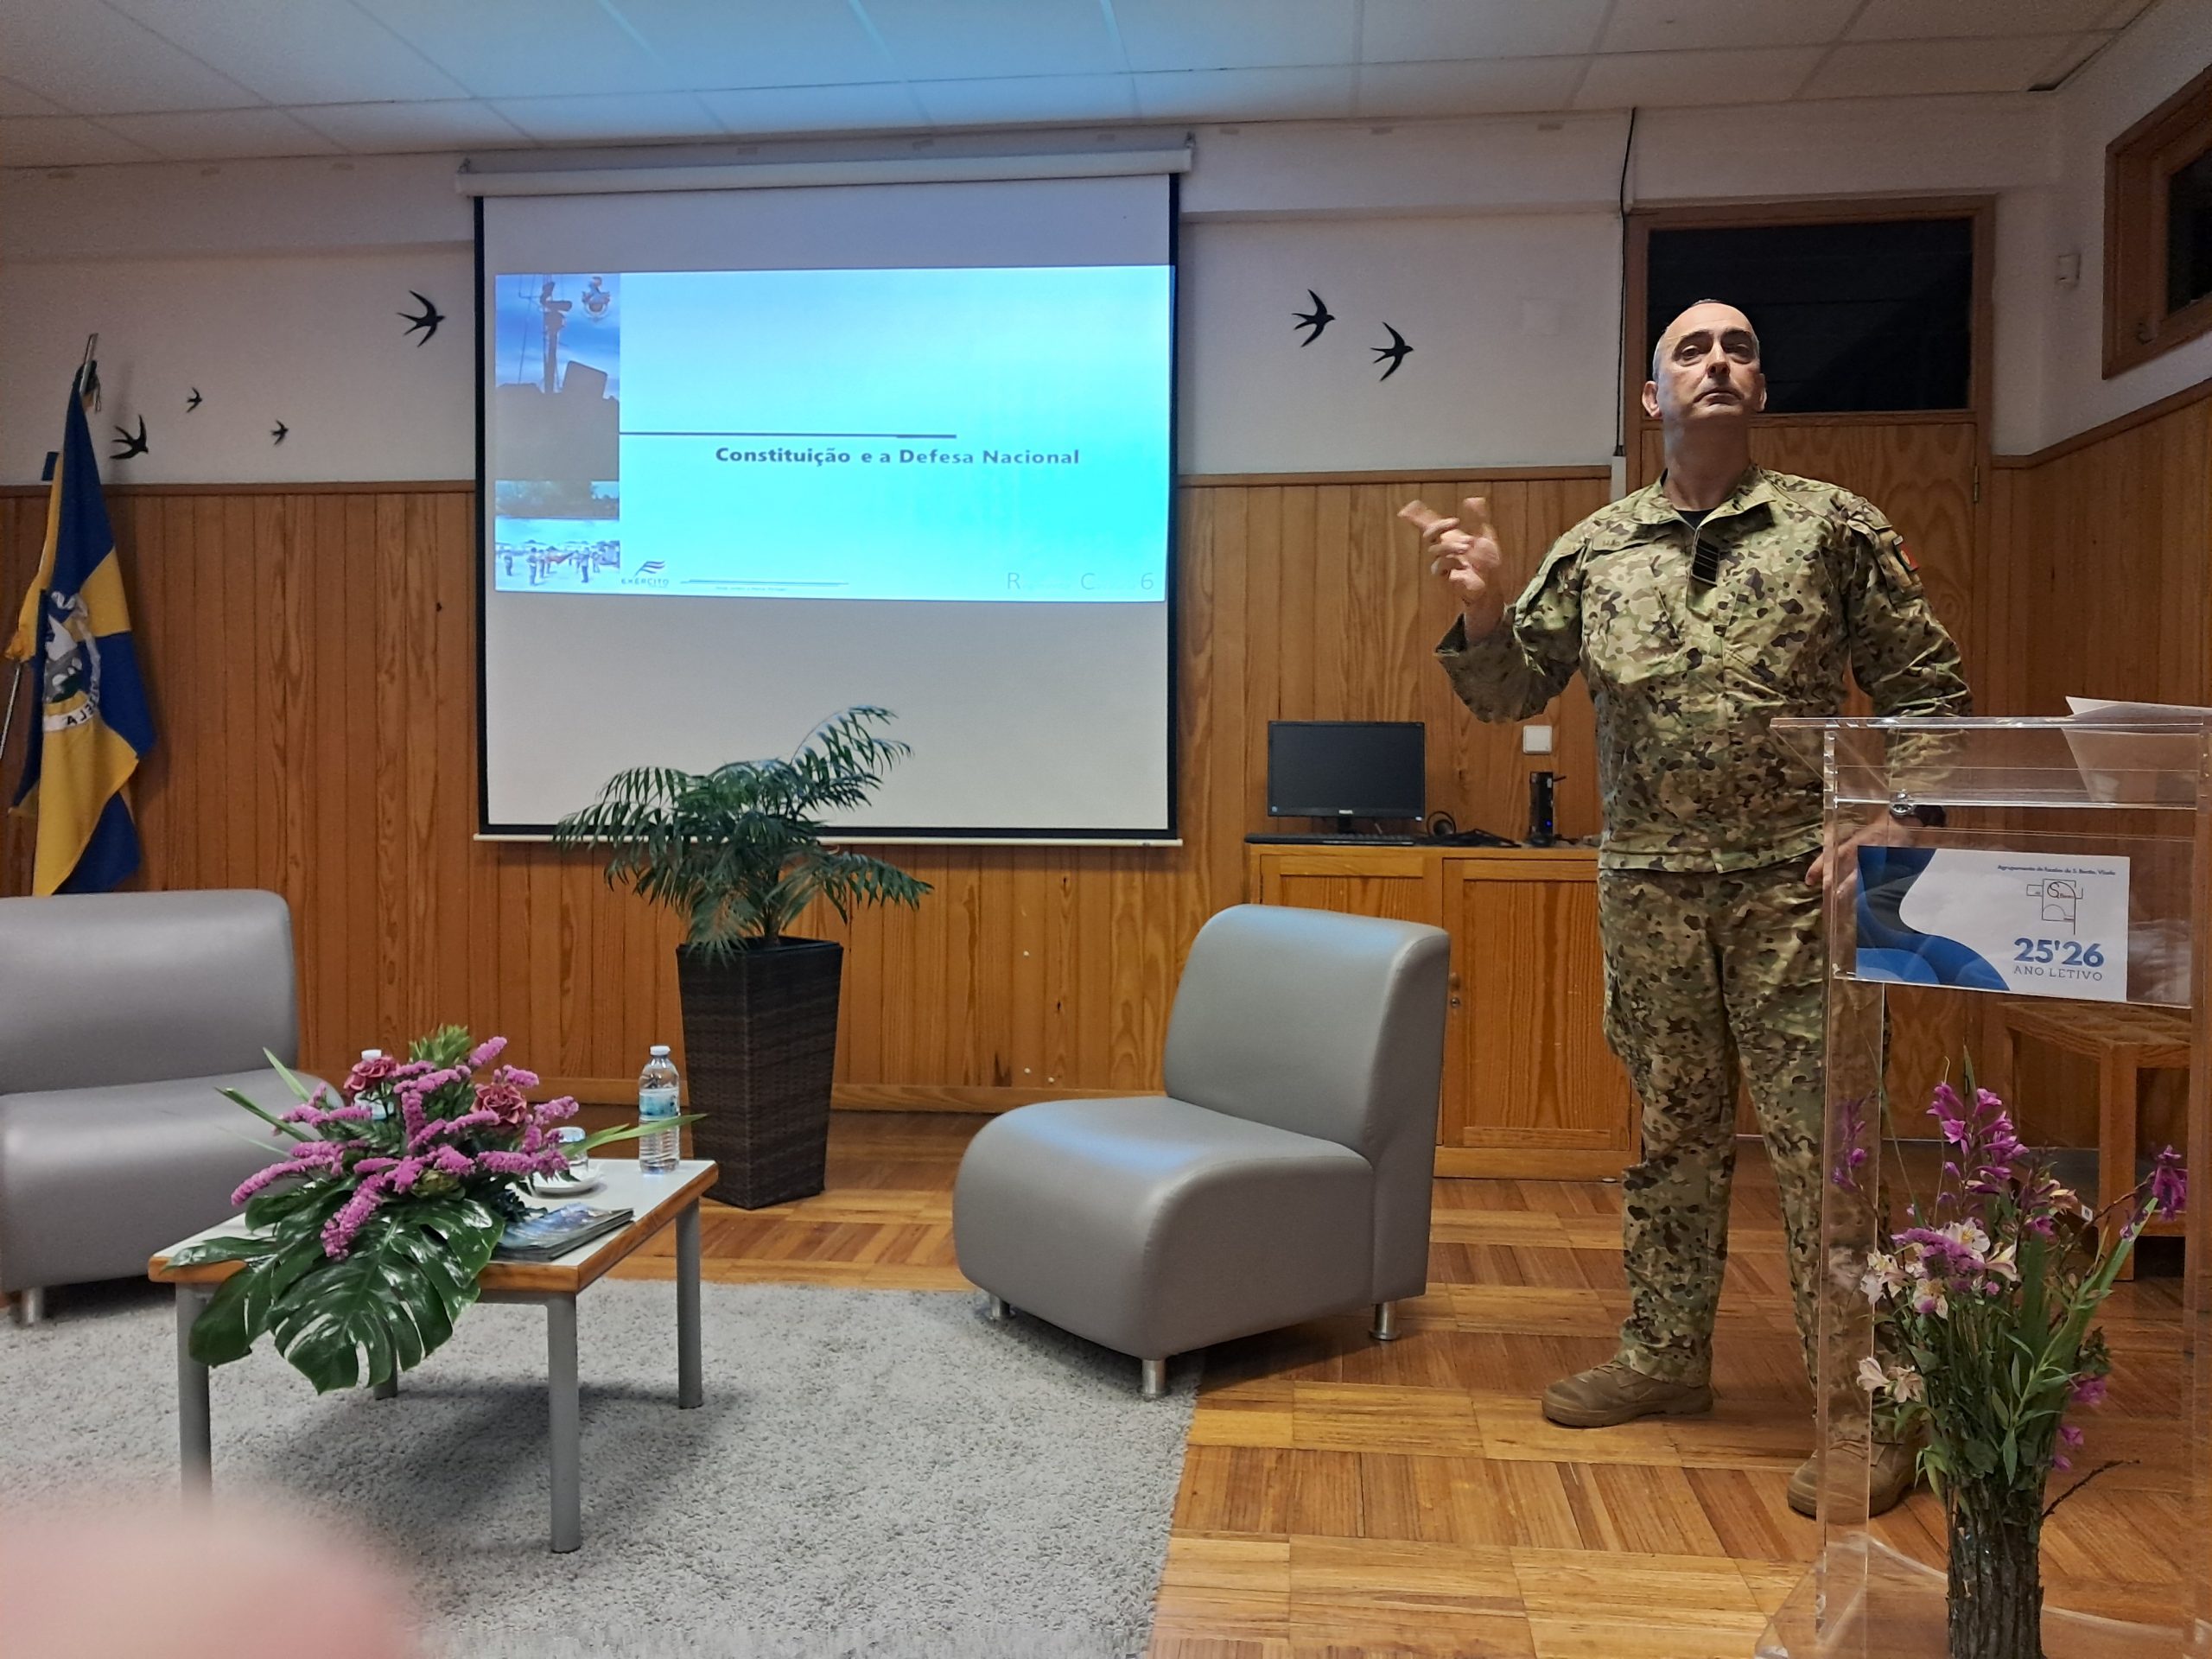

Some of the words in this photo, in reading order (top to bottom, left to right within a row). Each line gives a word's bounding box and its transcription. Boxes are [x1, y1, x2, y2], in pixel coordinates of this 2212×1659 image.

[715, 447, 851, 467] Constituição
[861, 452, 873, 463] e
[880, 452, 891, 464] a
[899, 448, 974, 464] Defesa
[982, 449, 1079, 465] Nacional
[2013, 938, 2105, 968] 25'26
[2014, 965, 2044, 976] ANO
[2050, 968, 2102, 982] LETIVO
